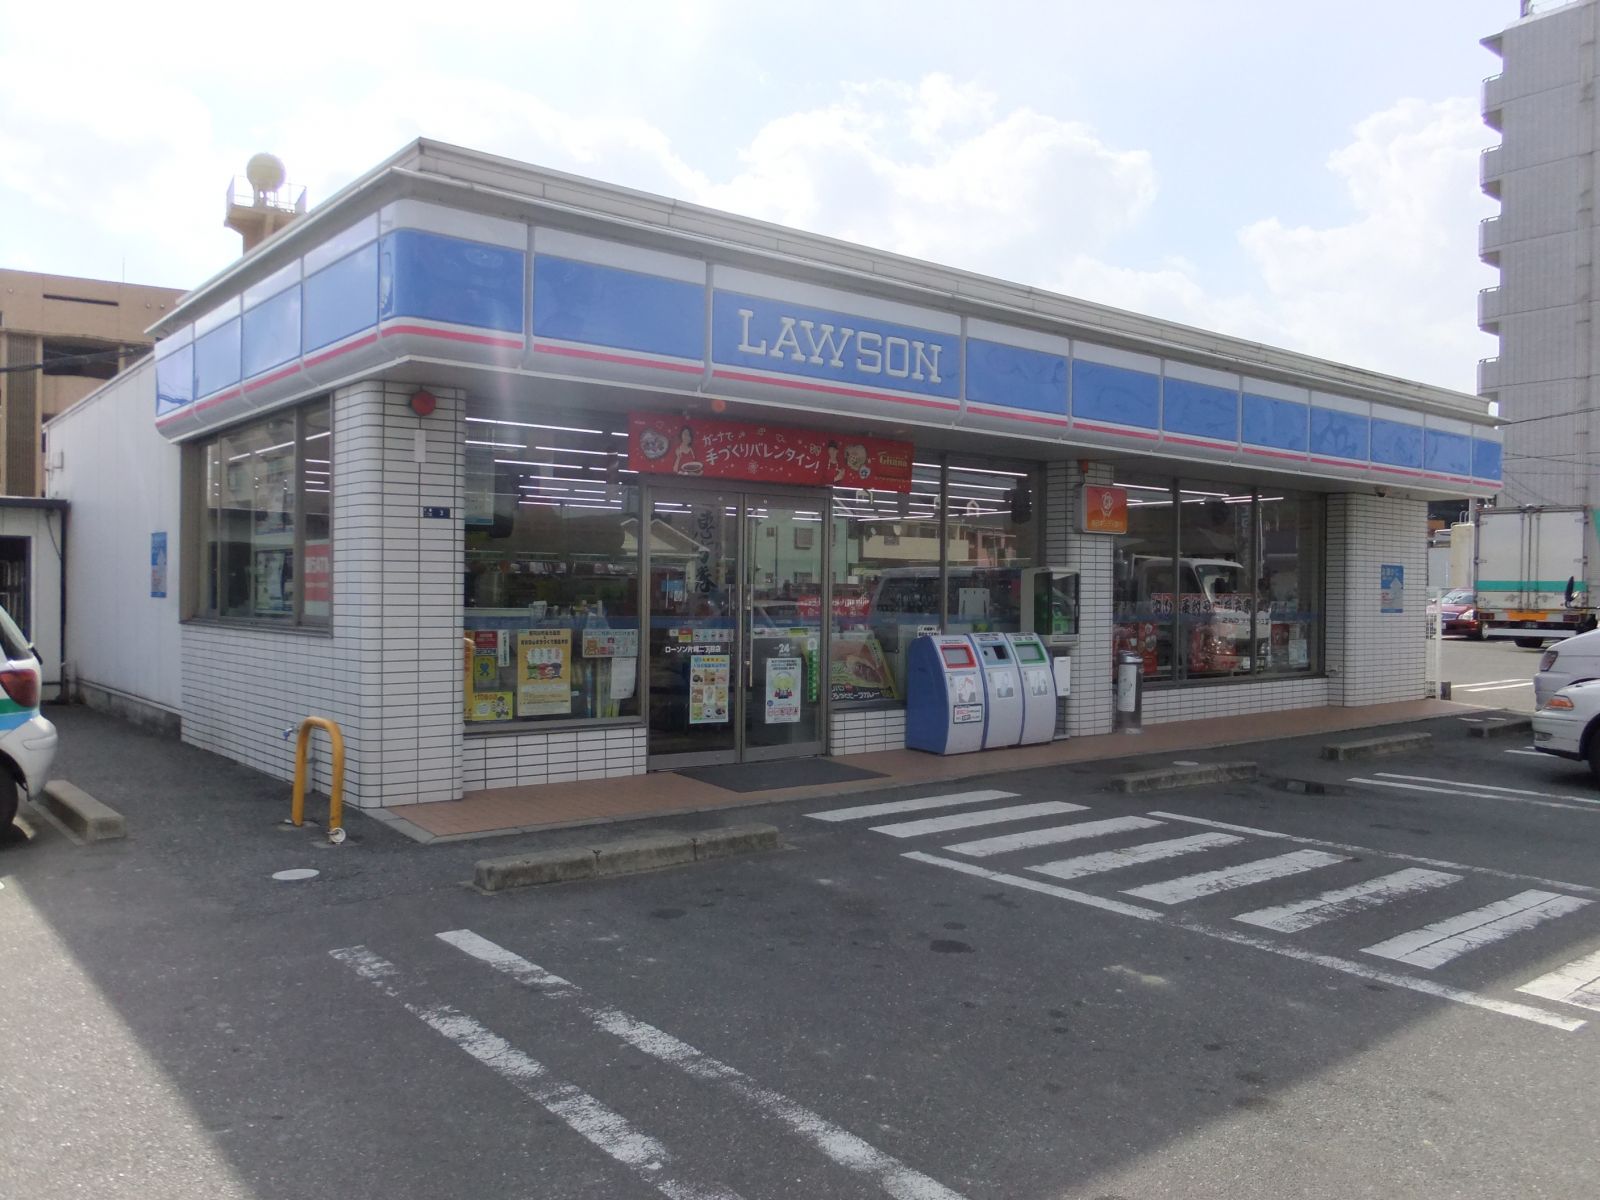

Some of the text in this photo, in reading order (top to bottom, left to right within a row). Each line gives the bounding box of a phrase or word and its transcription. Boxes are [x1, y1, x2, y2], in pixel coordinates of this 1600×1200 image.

[737, 309, 942, 384] LAWSON
[702, 431, 733, 447] ガーナで
